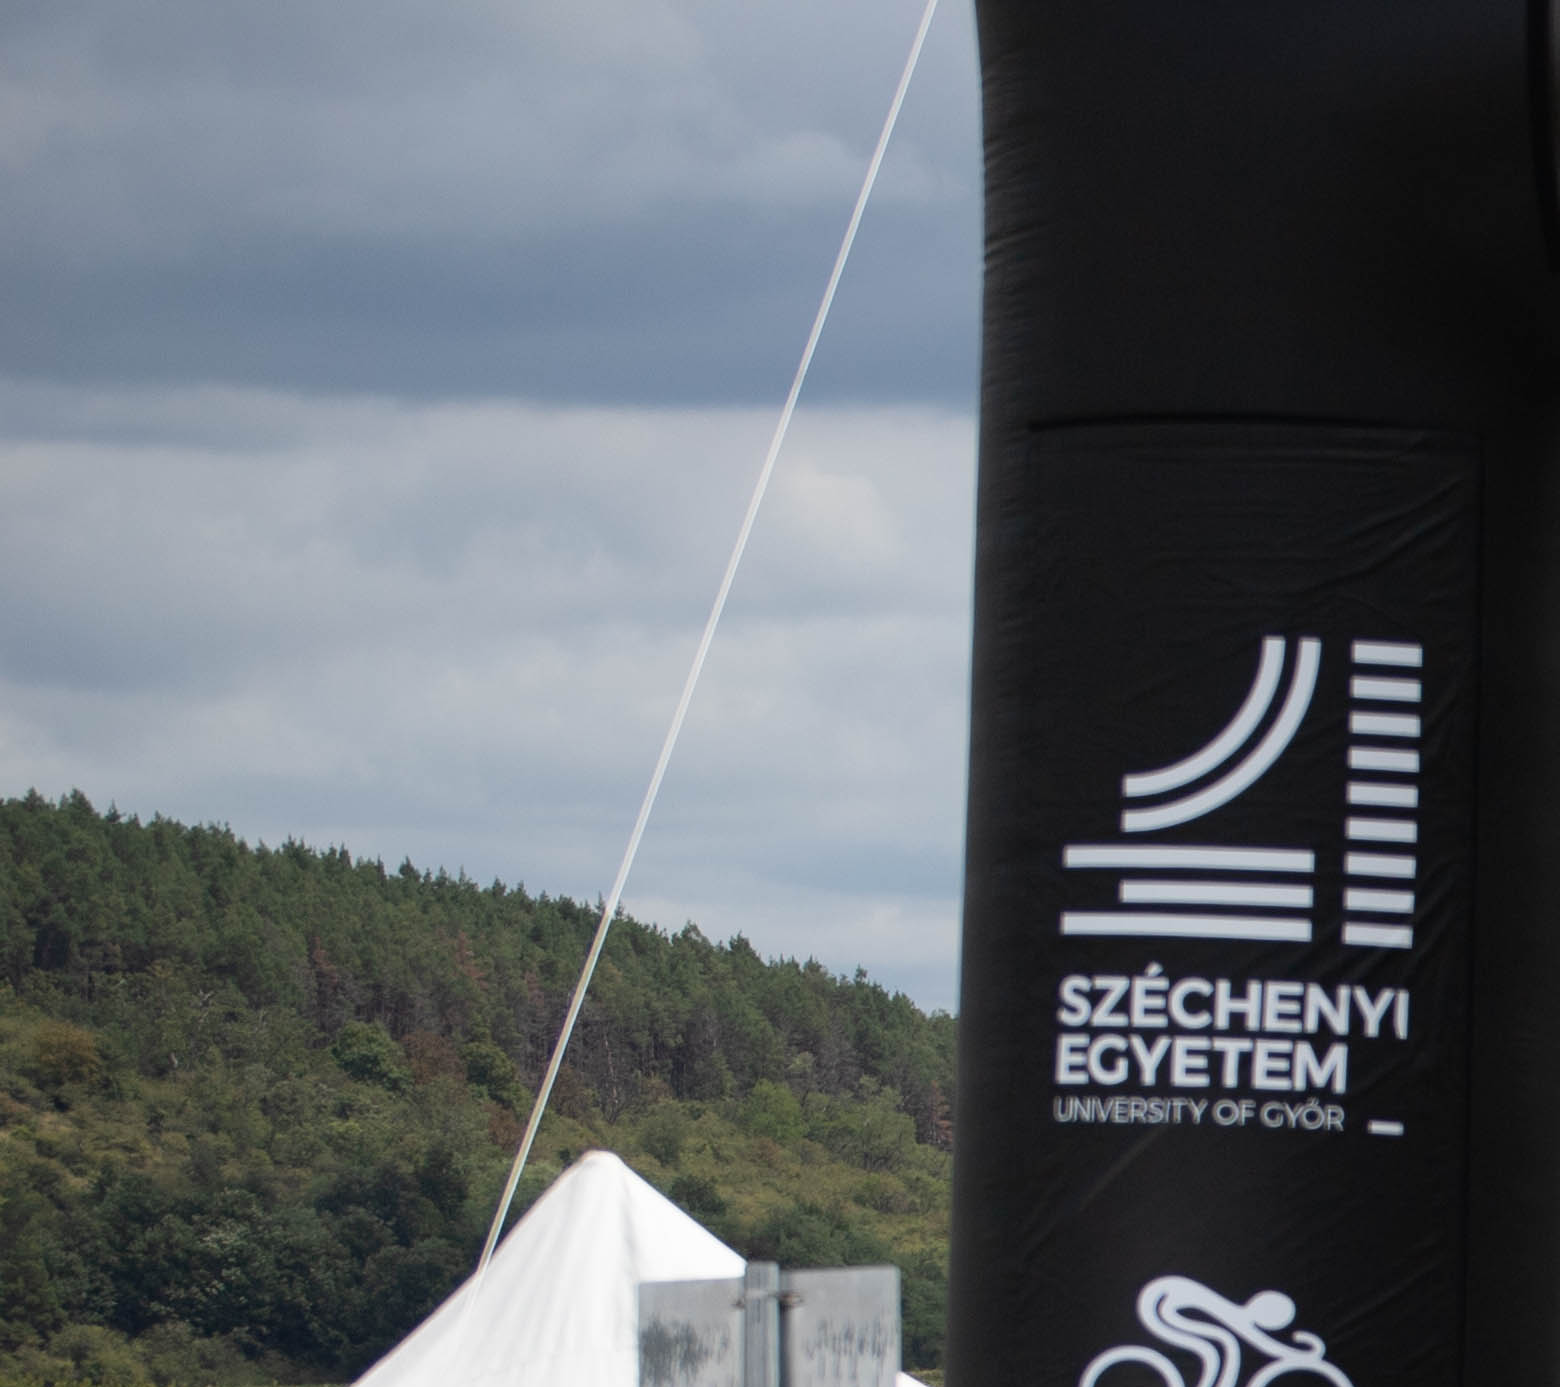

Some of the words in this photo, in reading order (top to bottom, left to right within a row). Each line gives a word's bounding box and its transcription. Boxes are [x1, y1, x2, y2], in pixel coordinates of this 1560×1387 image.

[1057, 962, 1410, 1040] SZÉCHENYI
[1055, 1033, 1348, 1094] EGYETEM
[1053, 1096, 1207, 1124] UNIVERSITY
[1211, 1099, 1256, 1126] OF
[1259, 1097, 1345, 1132] GYŐR
